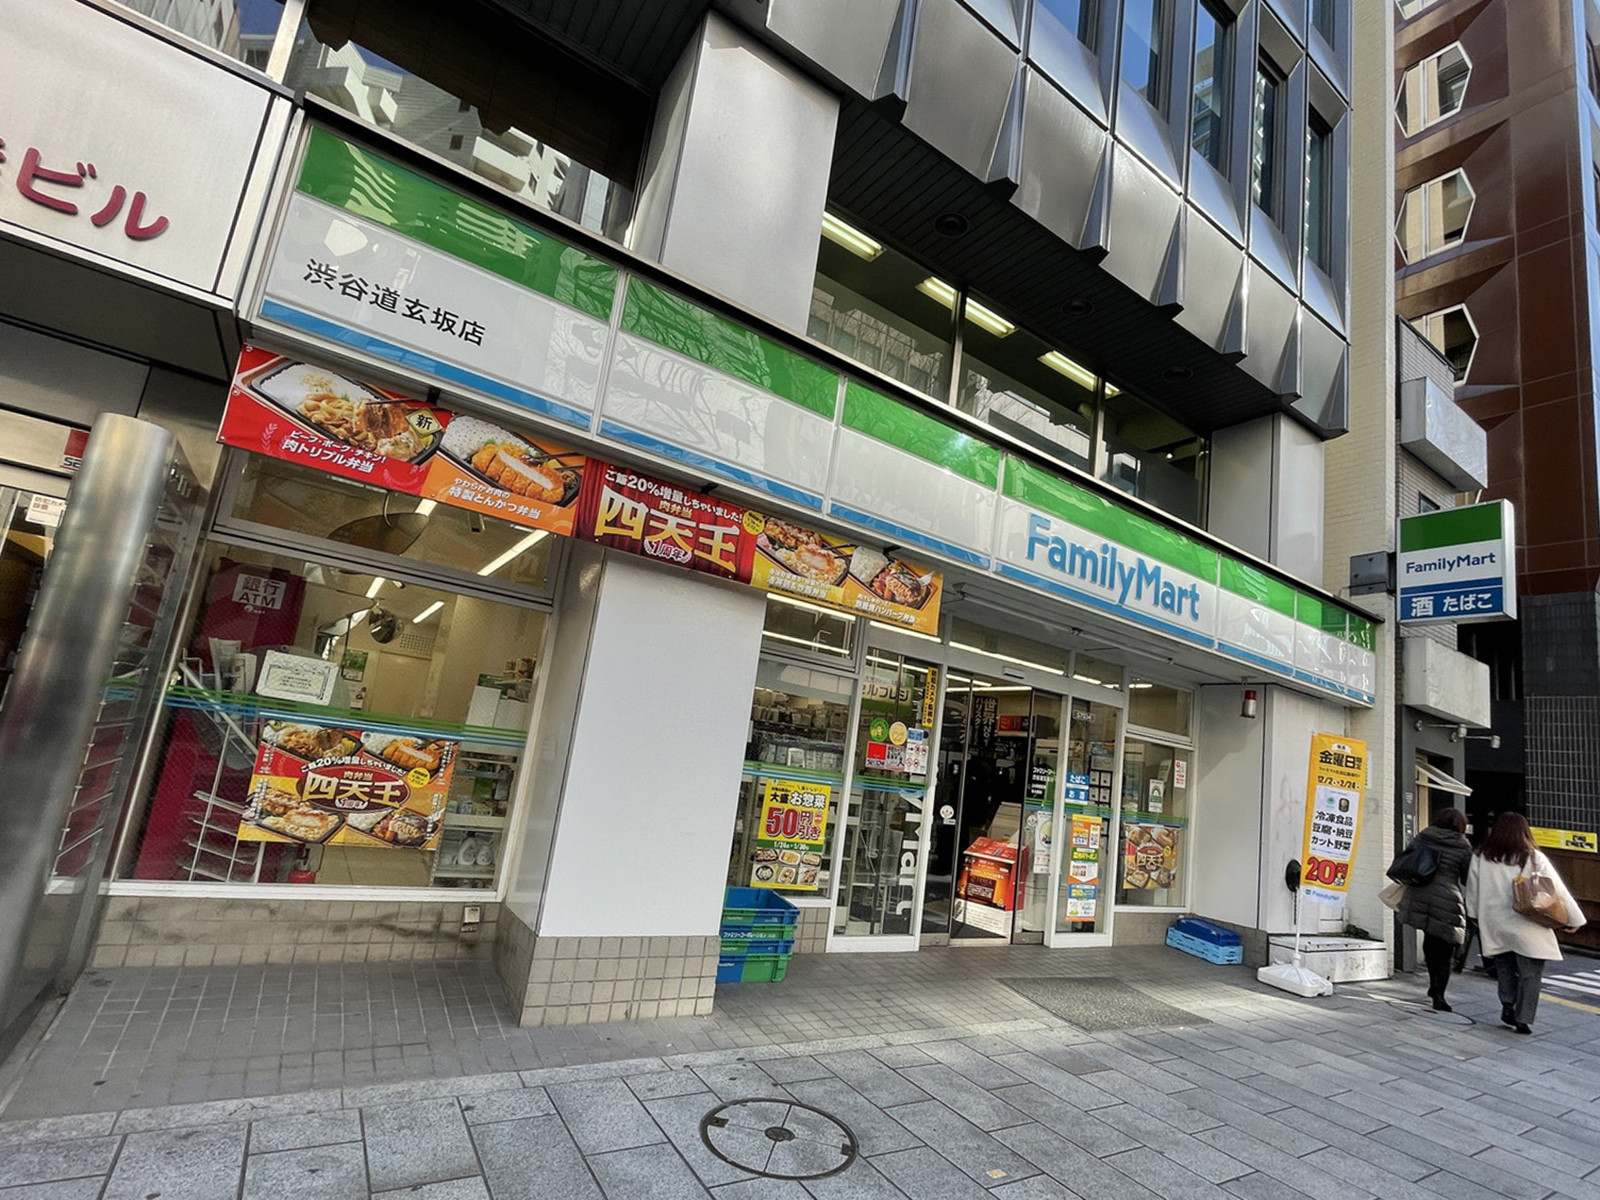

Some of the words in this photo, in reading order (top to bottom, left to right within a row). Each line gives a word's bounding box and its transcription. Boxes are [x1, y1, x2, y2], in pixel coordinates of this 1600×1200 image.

[0, 137, 169, 241] ビル
[303, 259, 485, 346] 渋谷道玄坂店
[416, 413, 433, 431] 新
[282, 439, 375, 474] 肉トリプル弁当
[448, 486, 542, 520] 特製とんかつ弁当
[659, 500, 693, 519] 肉弁当
[594, 484, 740, 573] 四天王
[651, 539, 686, 561] 1周年
[1025, 512, 1200, 621] FamilyMart
[1406, 553, 1496, 574] FamilyMart
[242, 576, 281, 596] 銀行
[238, 592, 276, 608] ATM
[1411, 596, 1434, 617] 酒
[1443, 593, 1493, 612] たばこ
[1319, 750, 1355, 769] 金曜日
[302, 772, 404, 808] 四天王
[790, 791, 826, 809] お惣菜
[1315, 810, 1353, 826] 冷凍食品
[1311, 836, 1351, 851] カット野菜
